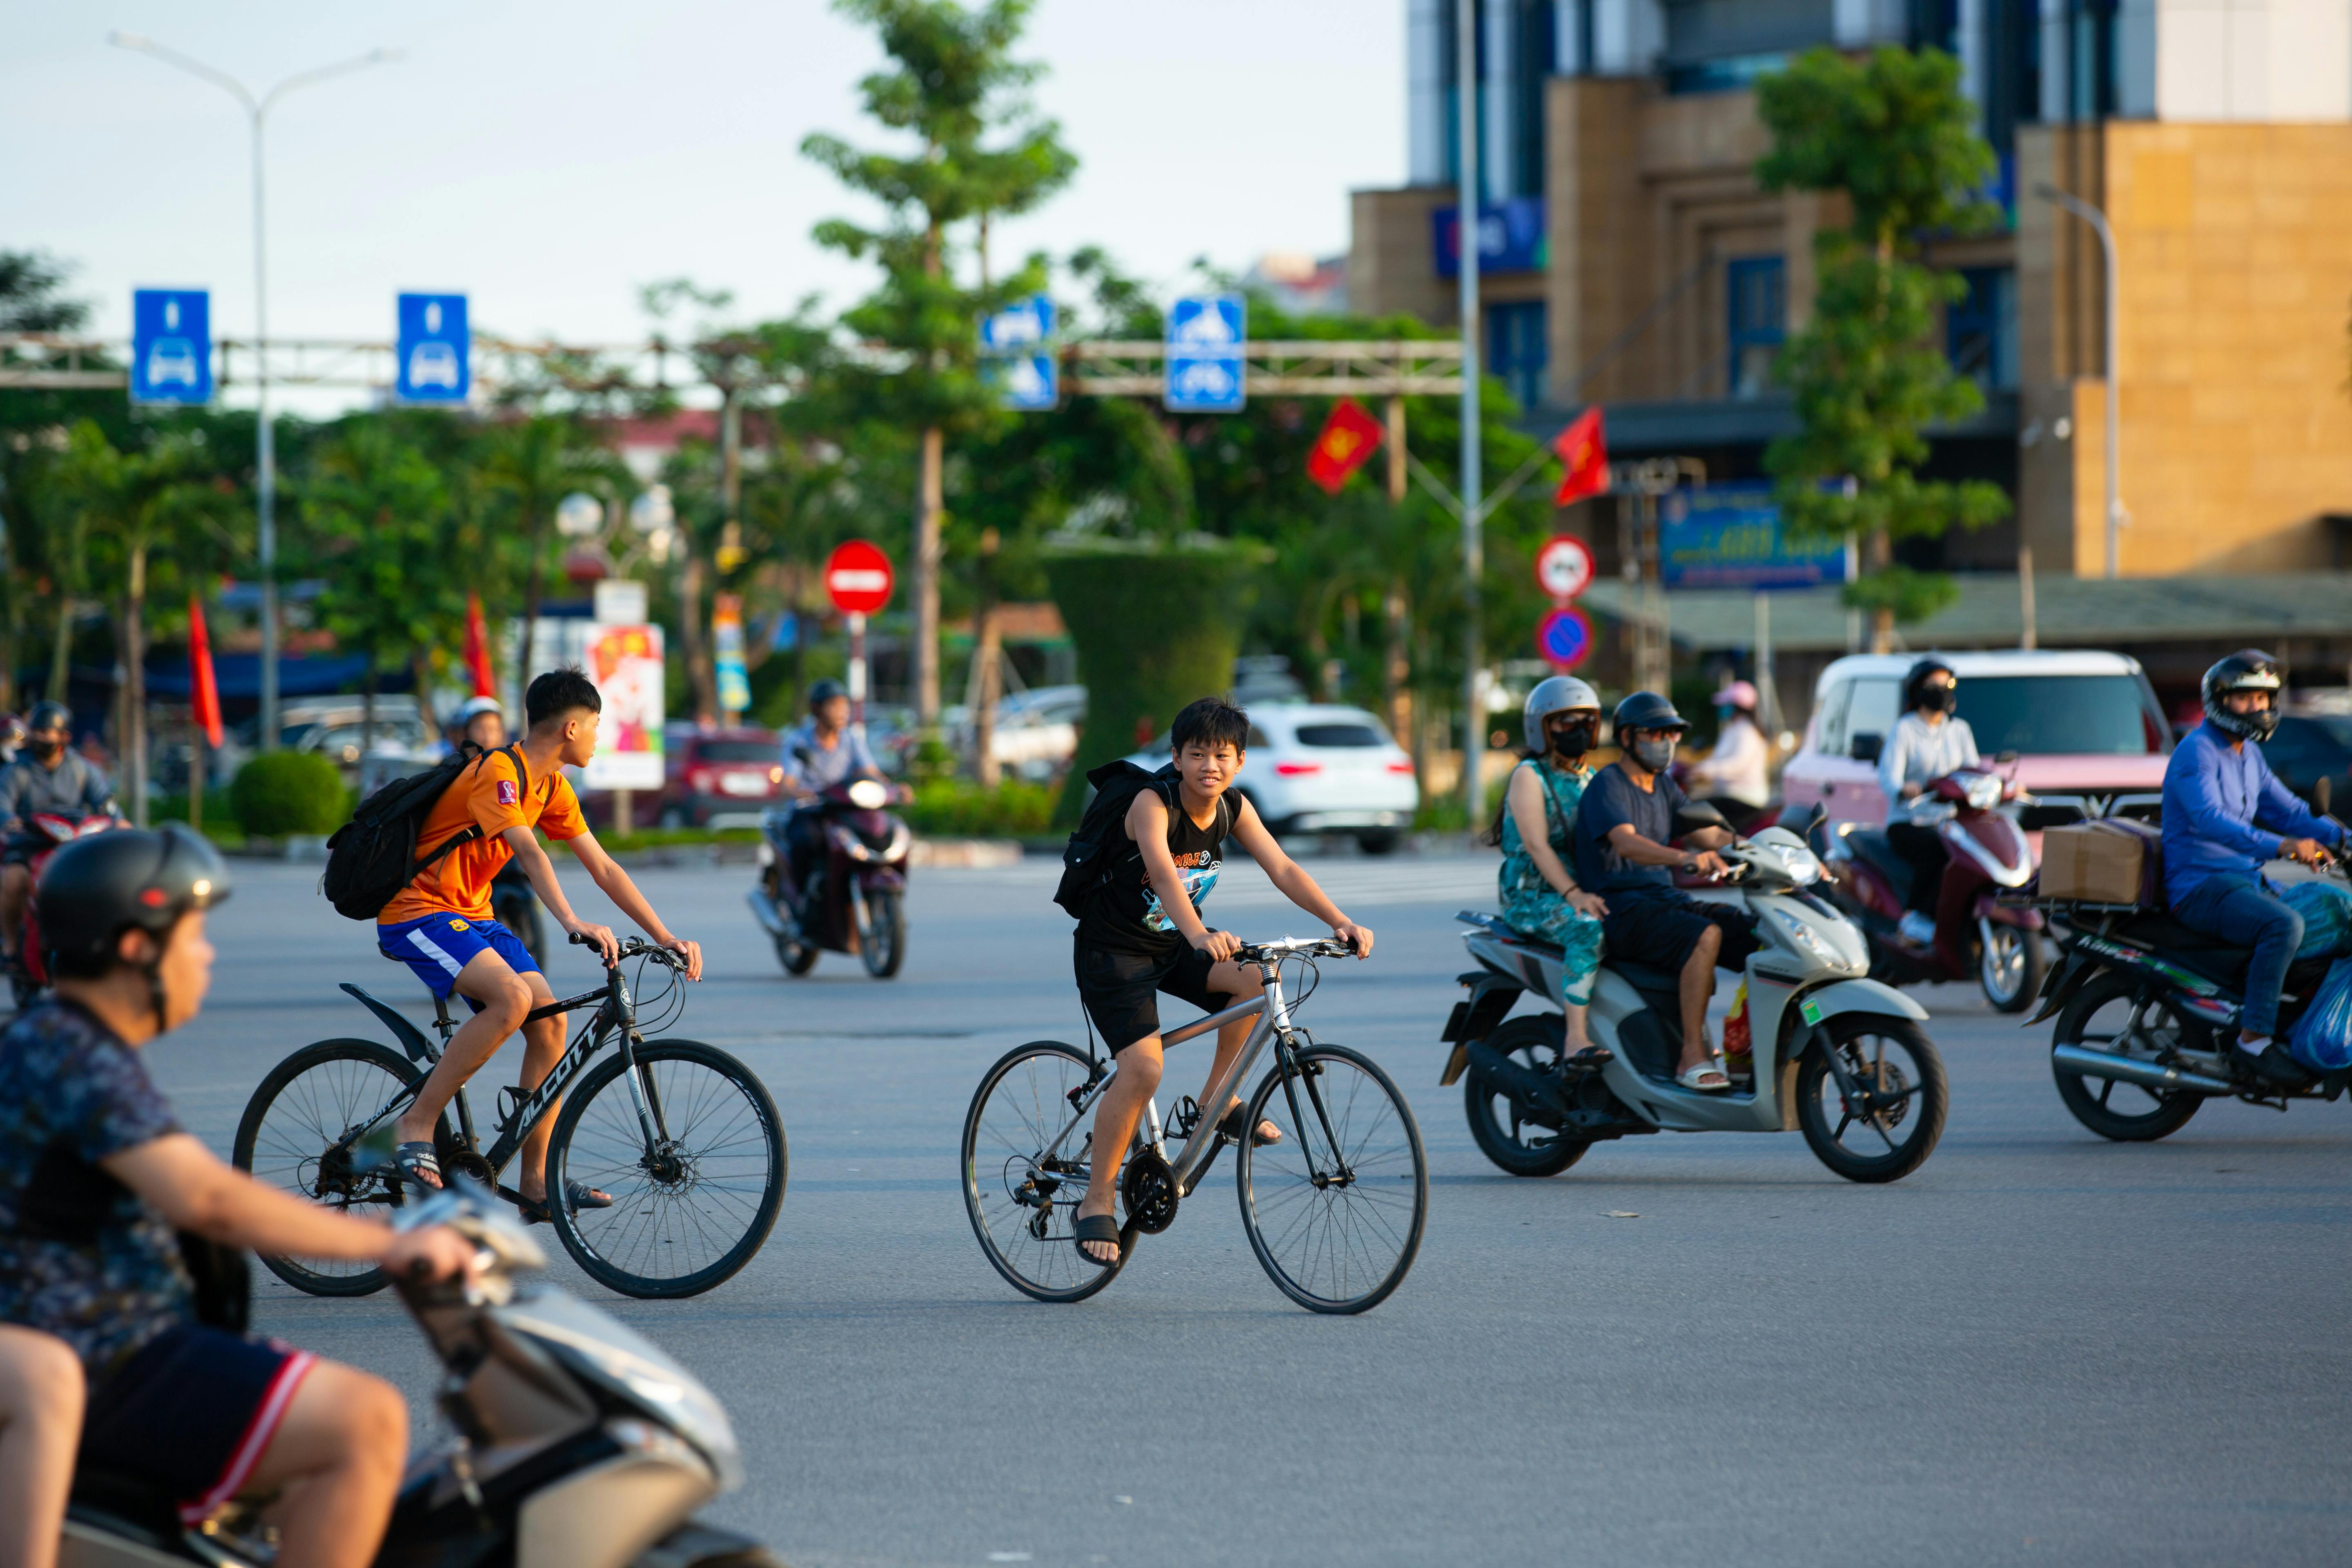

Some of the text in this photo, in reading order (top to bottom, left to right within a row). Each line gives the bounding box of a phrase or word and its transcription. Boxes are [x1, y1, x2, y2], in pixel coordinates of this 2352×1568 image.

[515, 1017, 597, 1140] ALCOTT
[729, 1076, 766, 1124] ALCOTT
[361, 1100, 393, 1130] ALCOTT
